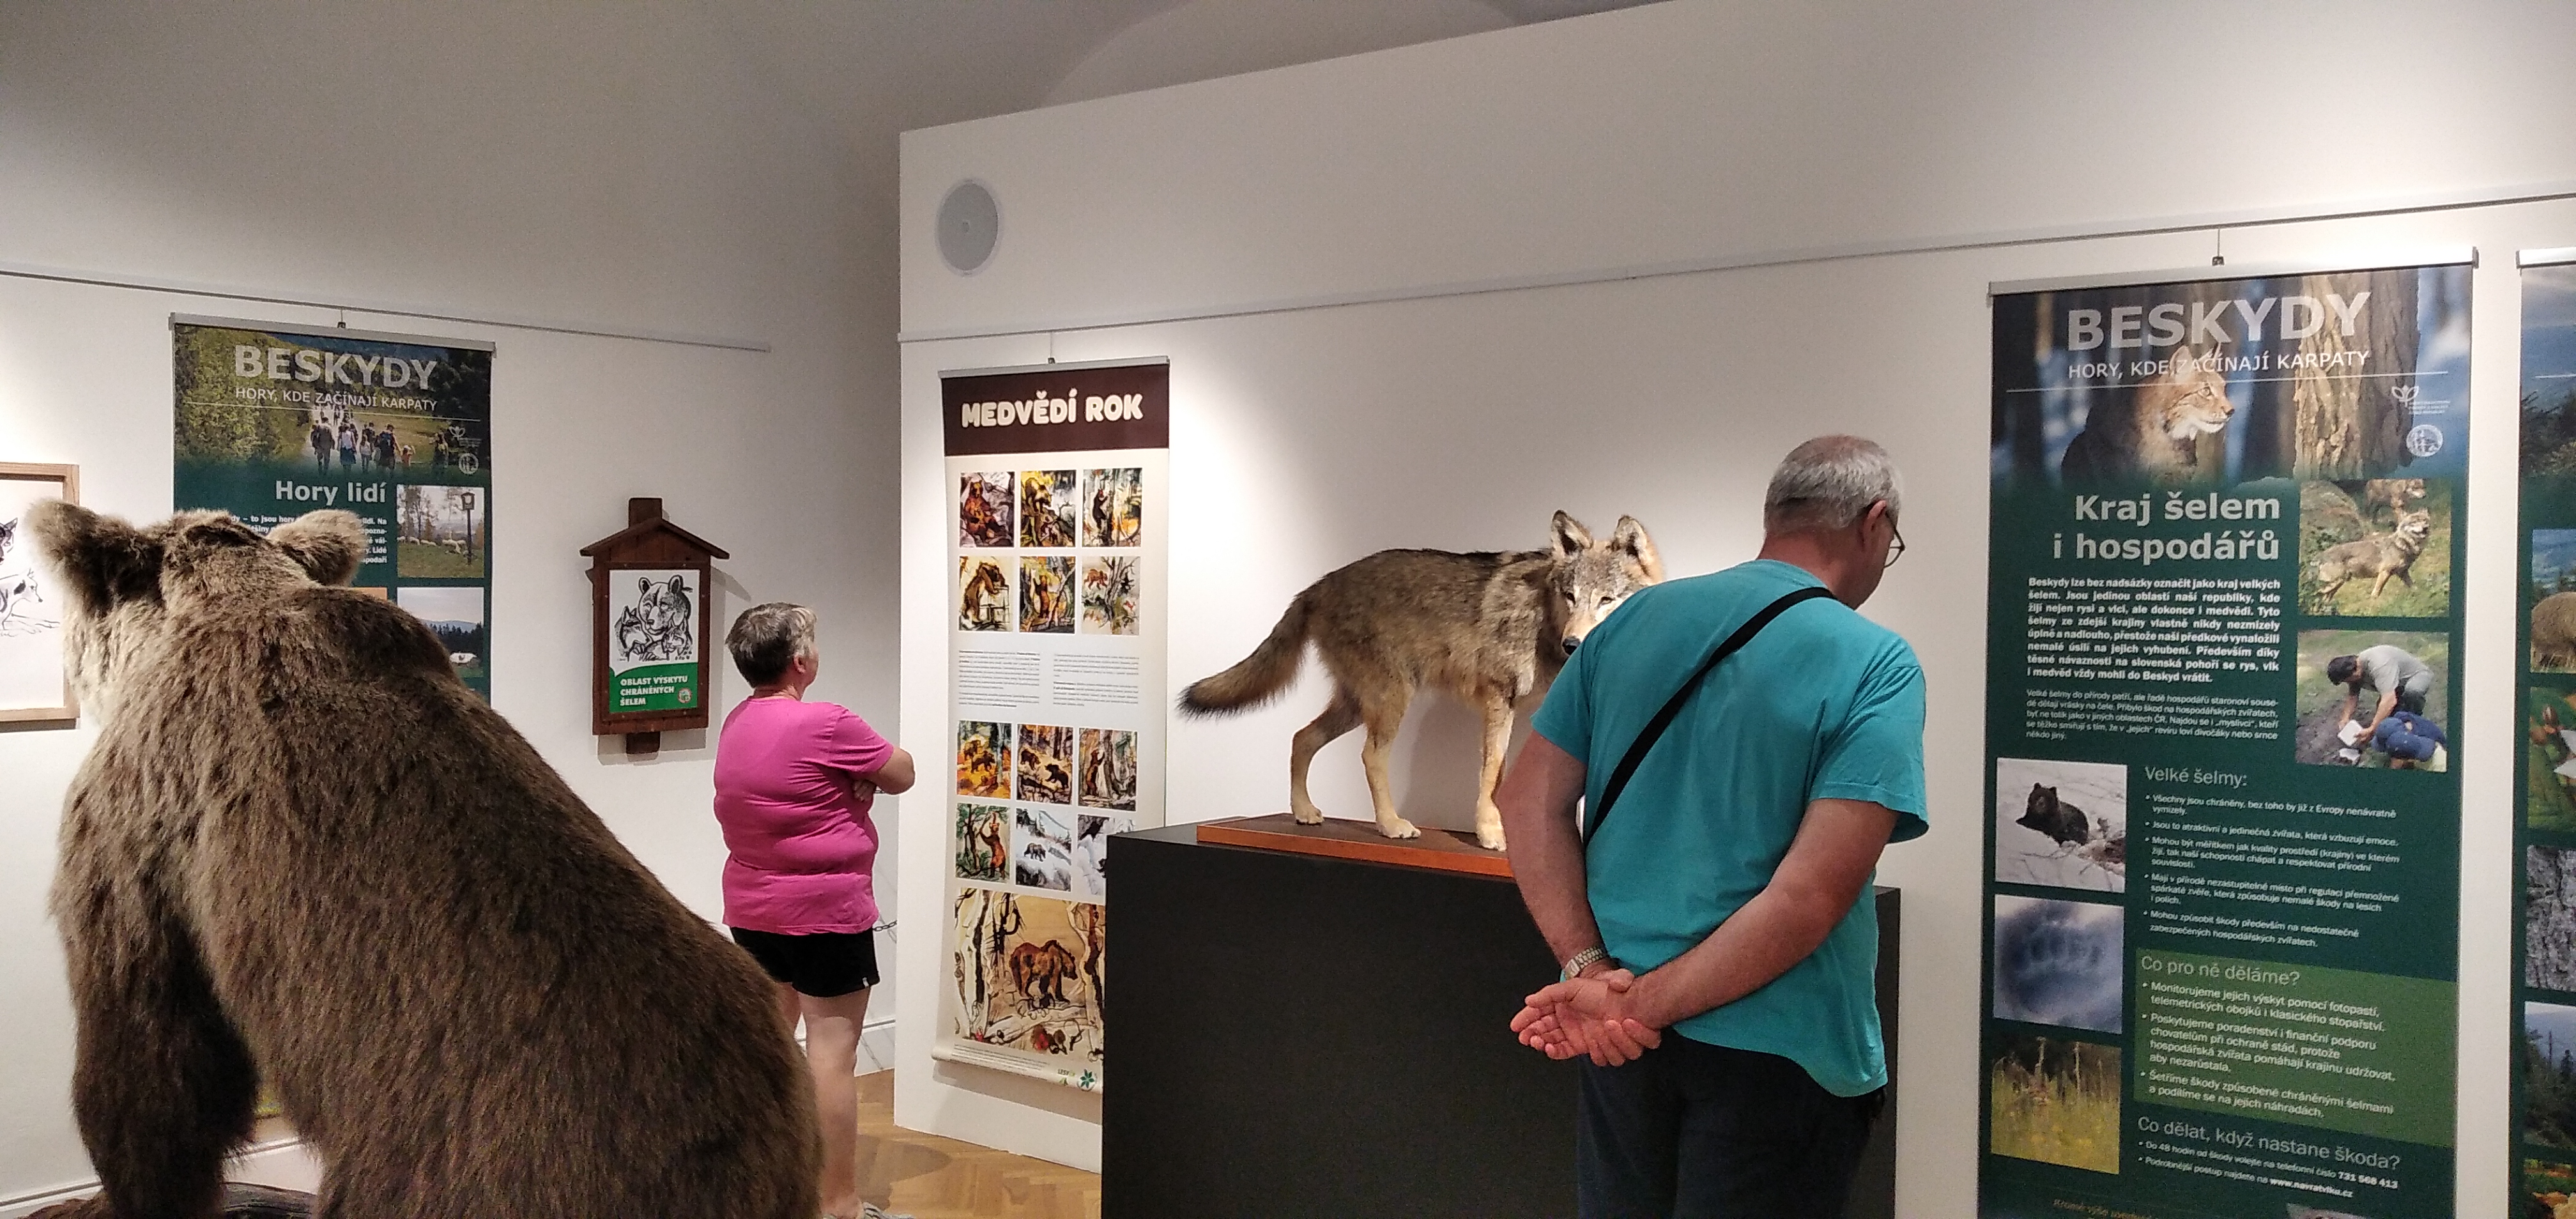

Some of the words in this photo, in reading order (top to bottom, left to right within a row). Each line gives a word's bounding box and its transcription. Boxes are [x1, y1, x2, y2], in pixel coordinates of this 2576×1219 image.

[2067, 292, 2372, 351] BESKYDY
[234, 344, 438, 390] BESKYDY
[2068, 362, 2124, 380] HORY,
[2130, 360, 2170, 377] KDE
[2176, 350, 2270, 374] ZAČÍNAJÍ
[2277, 351, 2370, 371] KARPATY
[235, 387, 278, 402] HORY,
[282, 390, 311, 403] KDE
[315, 391, 378, 408] ZAČÍNAJÍ
[381, 397, 438, 411] KARPATY
[961, 388, 1078, 428] MEDVĚDÍ
[1085, 393, 1144, 423] ROK
[275, 480, 339, 507] Hory
[348, 482, 387, 503] lidí
[2076, 493, 2151, 528] Kraj
[2164, 491, 2280, 520] šelem
[2053, 532, 2062, 560] i
[2076, 530, 2280, 567] hospodářů
[620, 677, 652, 686] OBLAST
[652, 675, 688, 684] VÝSKYTU
[619, 696, 647, 707] ŠELEM
[2145, 766, 2189, 783] Velké
[2193, 768, 2247, 790] šelmy:
[2142, 956, 2163, 971] Co
[2167, 962, 2194, 975] pro
[2199, 962, 2220, 978] ně
[2225, 965, 2301, 986] děláme?
[2138, 1116, 2159, 1133] Co
[2163, 1122, 2211, 1142] dělat,
[2216, 1128, 2254, 1149] když
[2258, 1138, 2330, 1159] nastane
[2334, 1146, 2400, 1170] škoda?
